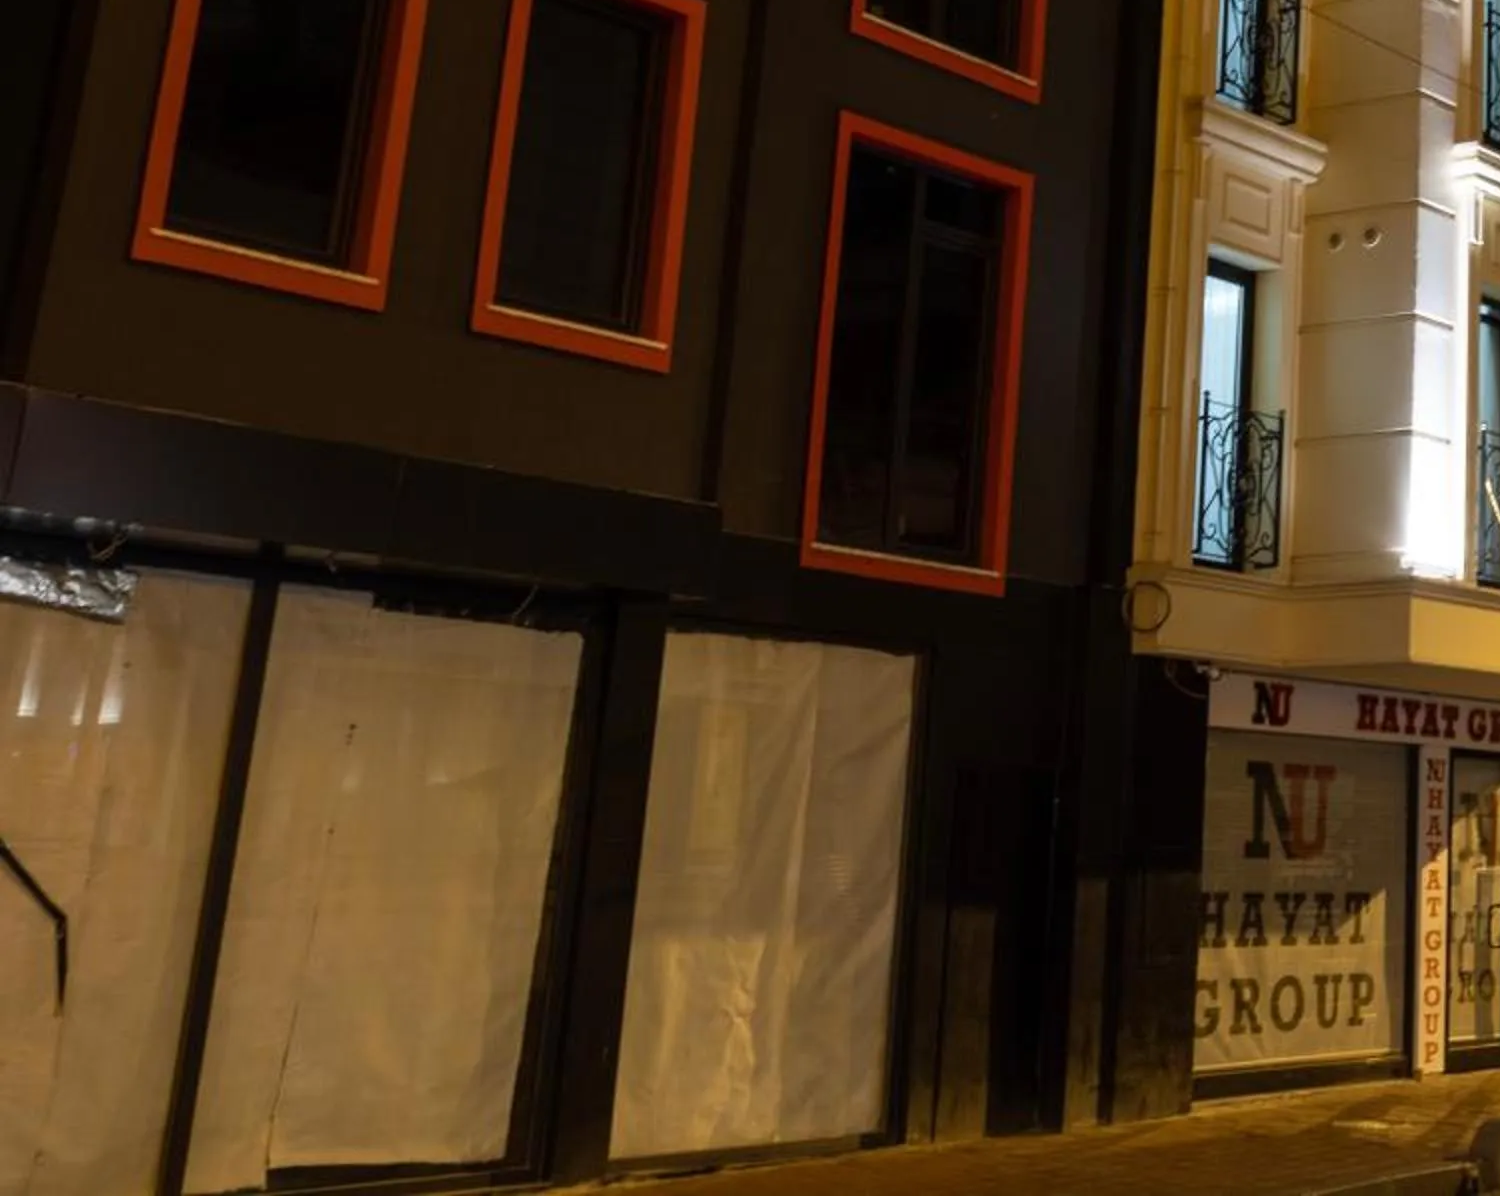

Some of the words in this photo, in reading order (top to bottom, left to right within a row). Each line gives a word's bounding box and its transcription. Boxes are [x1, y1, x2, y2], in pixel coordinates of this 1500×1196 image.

[1252, 681, 1294, 726] NU
[1355, 693, 1462, 738] HAYAT
[1242, 760, 1338, 860] NU
[1426, 787, 1445, 917] HAYAT
[1200, 891, 1371, 949] HAYAT
[1194, 972, 1375, 1039] GROUP
[1423, 928, 1445, 1064] GROUP
